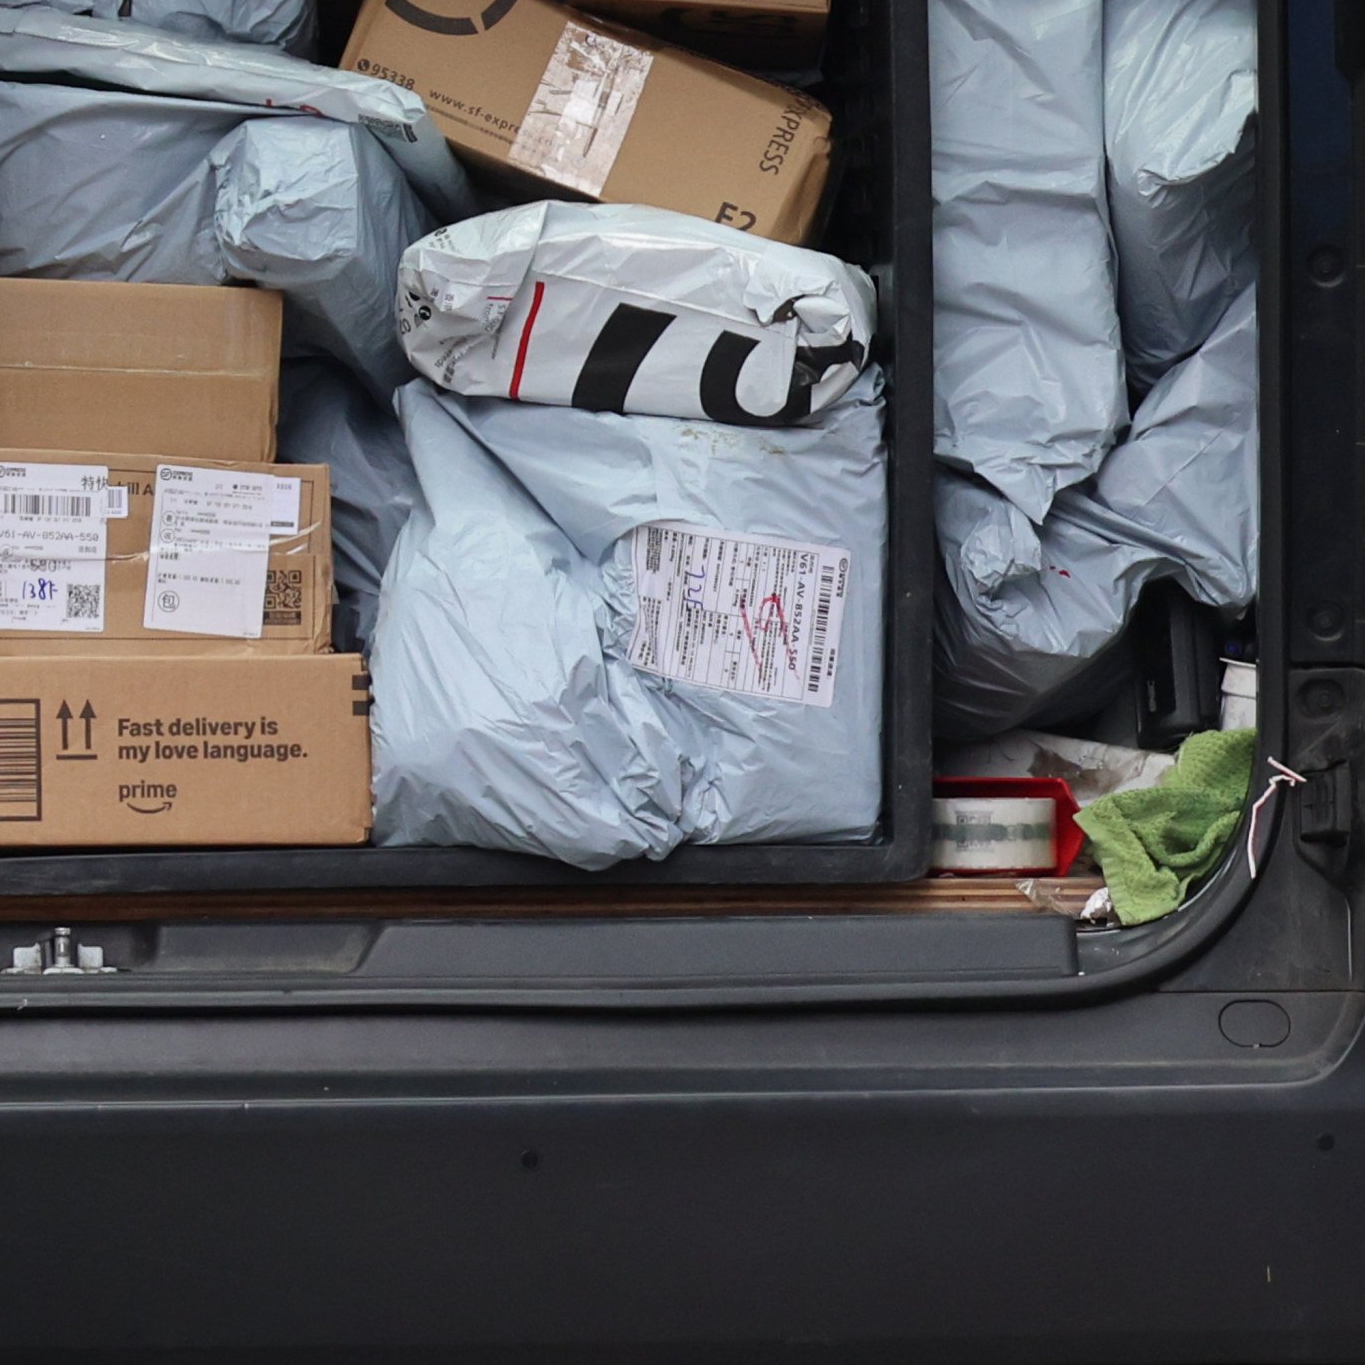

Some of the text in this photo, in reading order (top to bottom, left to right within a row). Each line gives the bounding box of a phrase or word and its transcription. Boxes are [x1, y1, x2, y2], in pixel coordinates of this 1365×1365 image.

[371, 63, 416, 91] 95338
[118, 716, 278, 740] Fast delivery is
[118, 741, 309, 764] my love language.
[118, 781, 178, 803] prime
